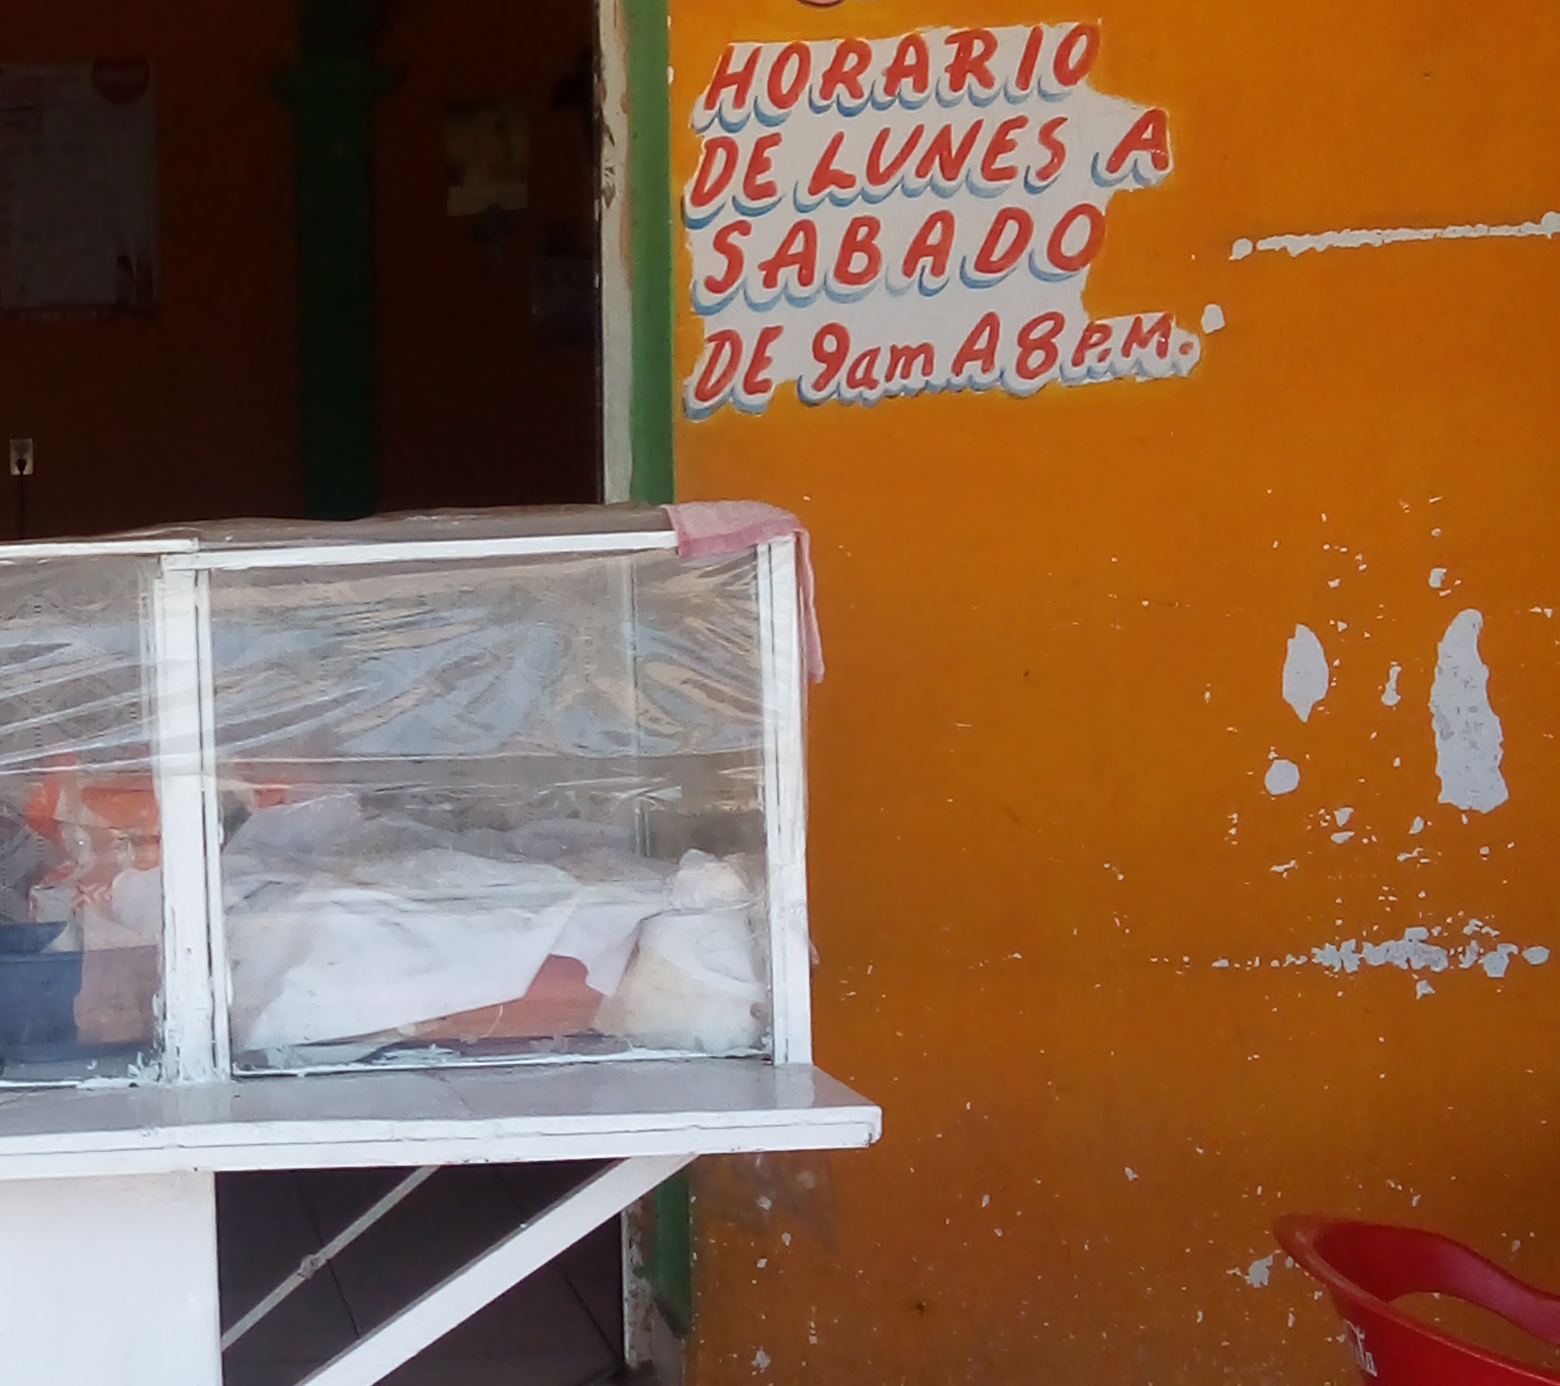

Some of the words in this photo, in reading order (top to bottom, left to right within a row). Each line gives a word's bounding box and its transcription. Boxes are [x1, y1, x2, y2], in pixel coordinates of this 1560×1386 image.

[698, 22, 1101, 132] HORARIO
[683, 132, 782, 228] DE
[794, 115, 1068, 211] LUNES
[1092, 107, 1171, 185] A
[691, 202, 1105, 315] SABADO
[684, 325, 782, 419] DE
[798, 321, 935, 405] 9am
[943, 311, 1002, 391] A
